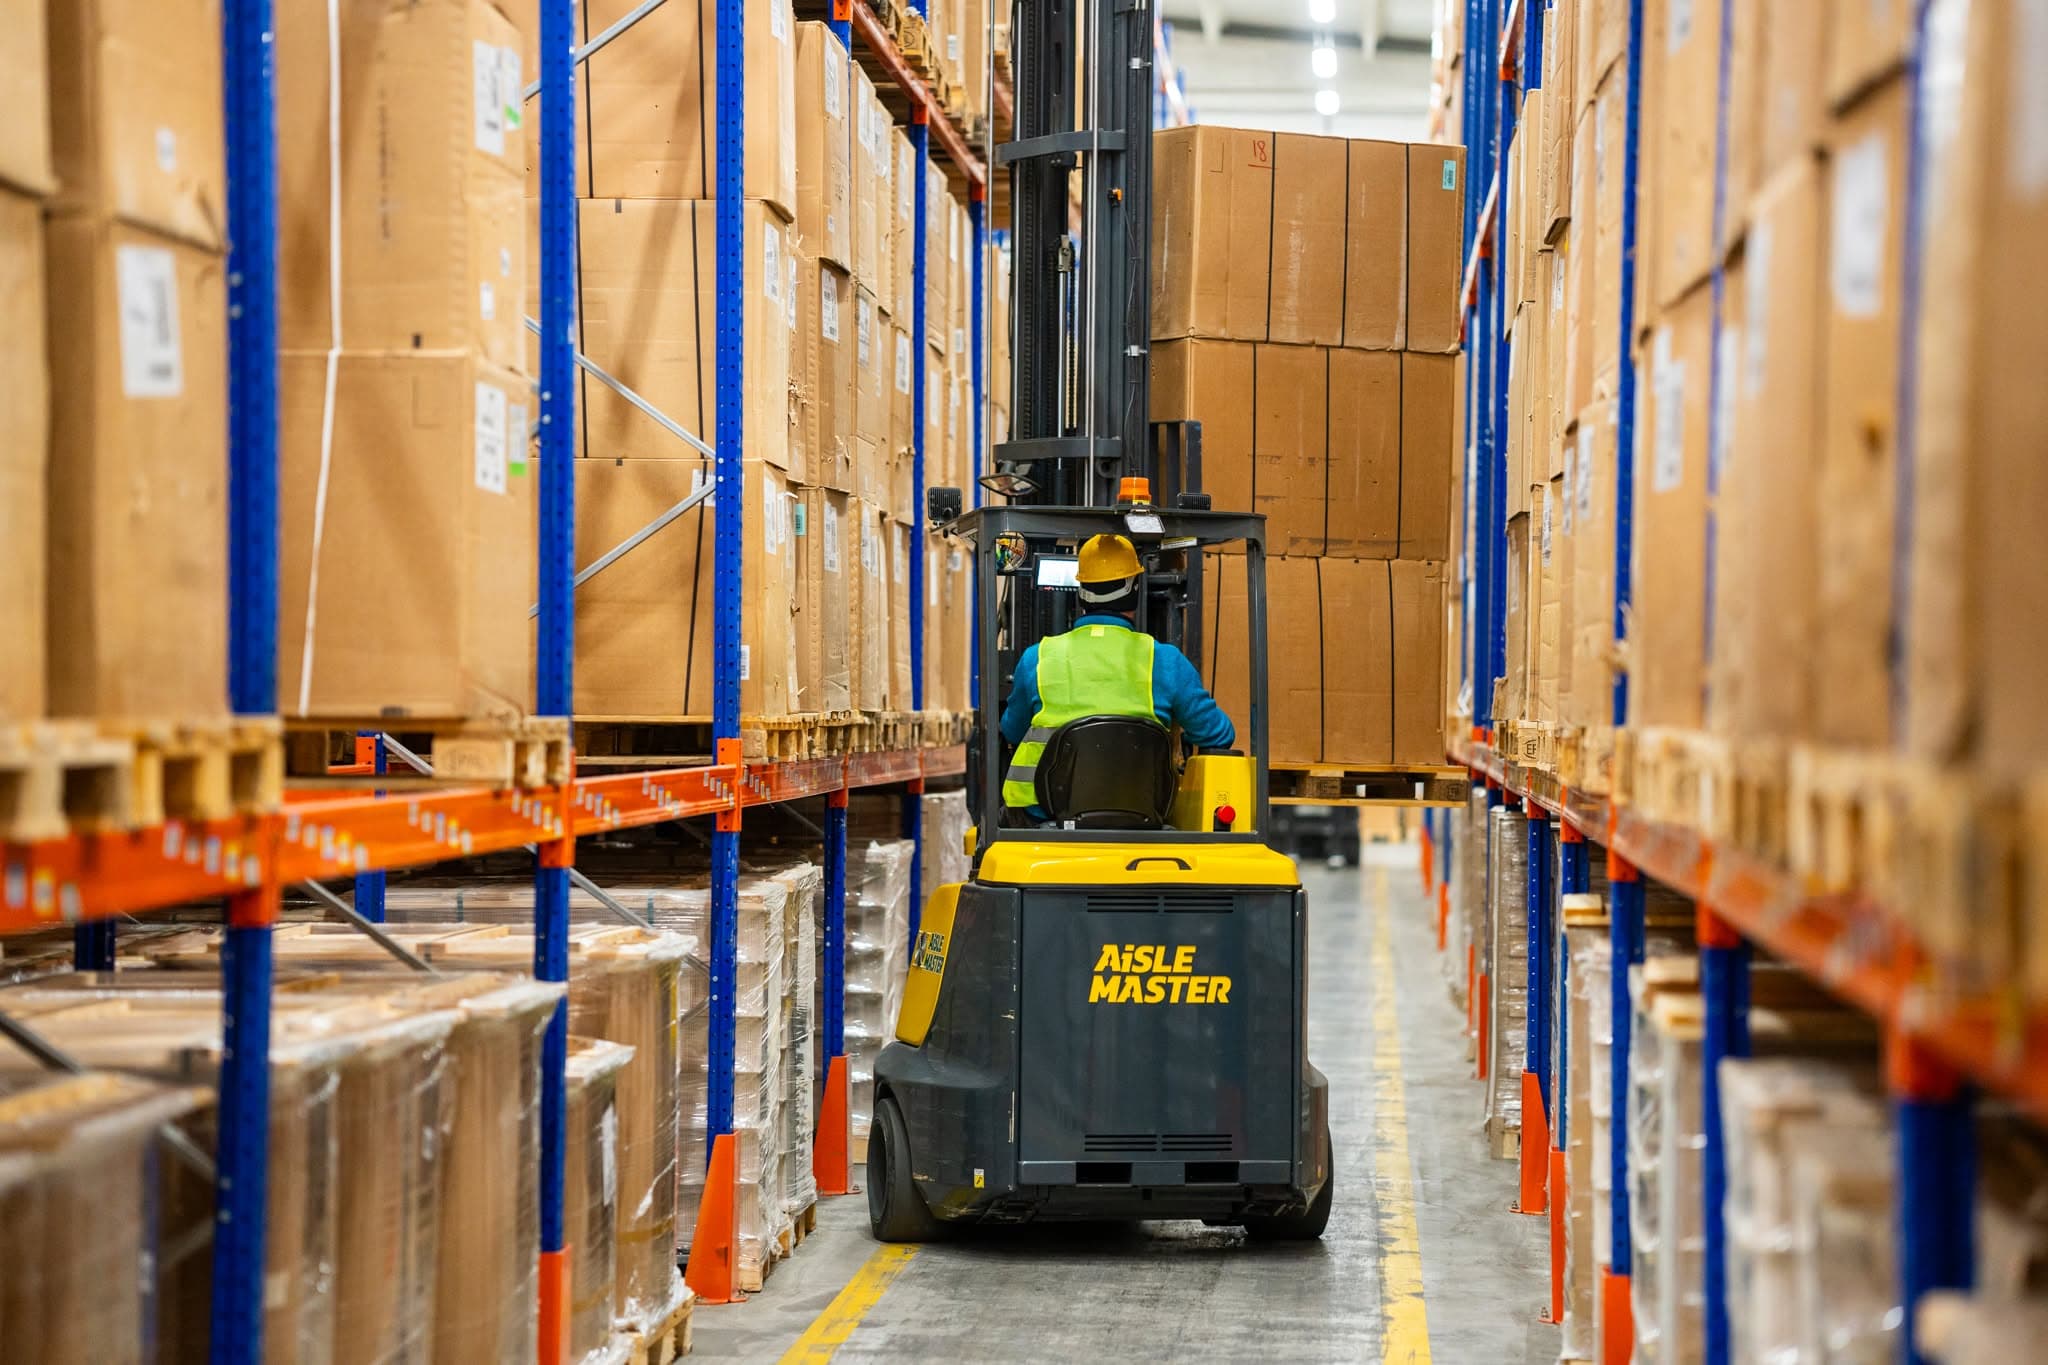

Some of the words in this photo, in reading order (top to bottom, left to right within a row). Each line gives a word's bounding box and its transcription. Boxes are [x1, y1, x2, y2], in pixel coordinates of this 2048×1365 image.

[1252, 140, 1267, 162] 18
[923, 953, 945, 974] MASTER
[1088, 975, 1232, 1004] MASTER
